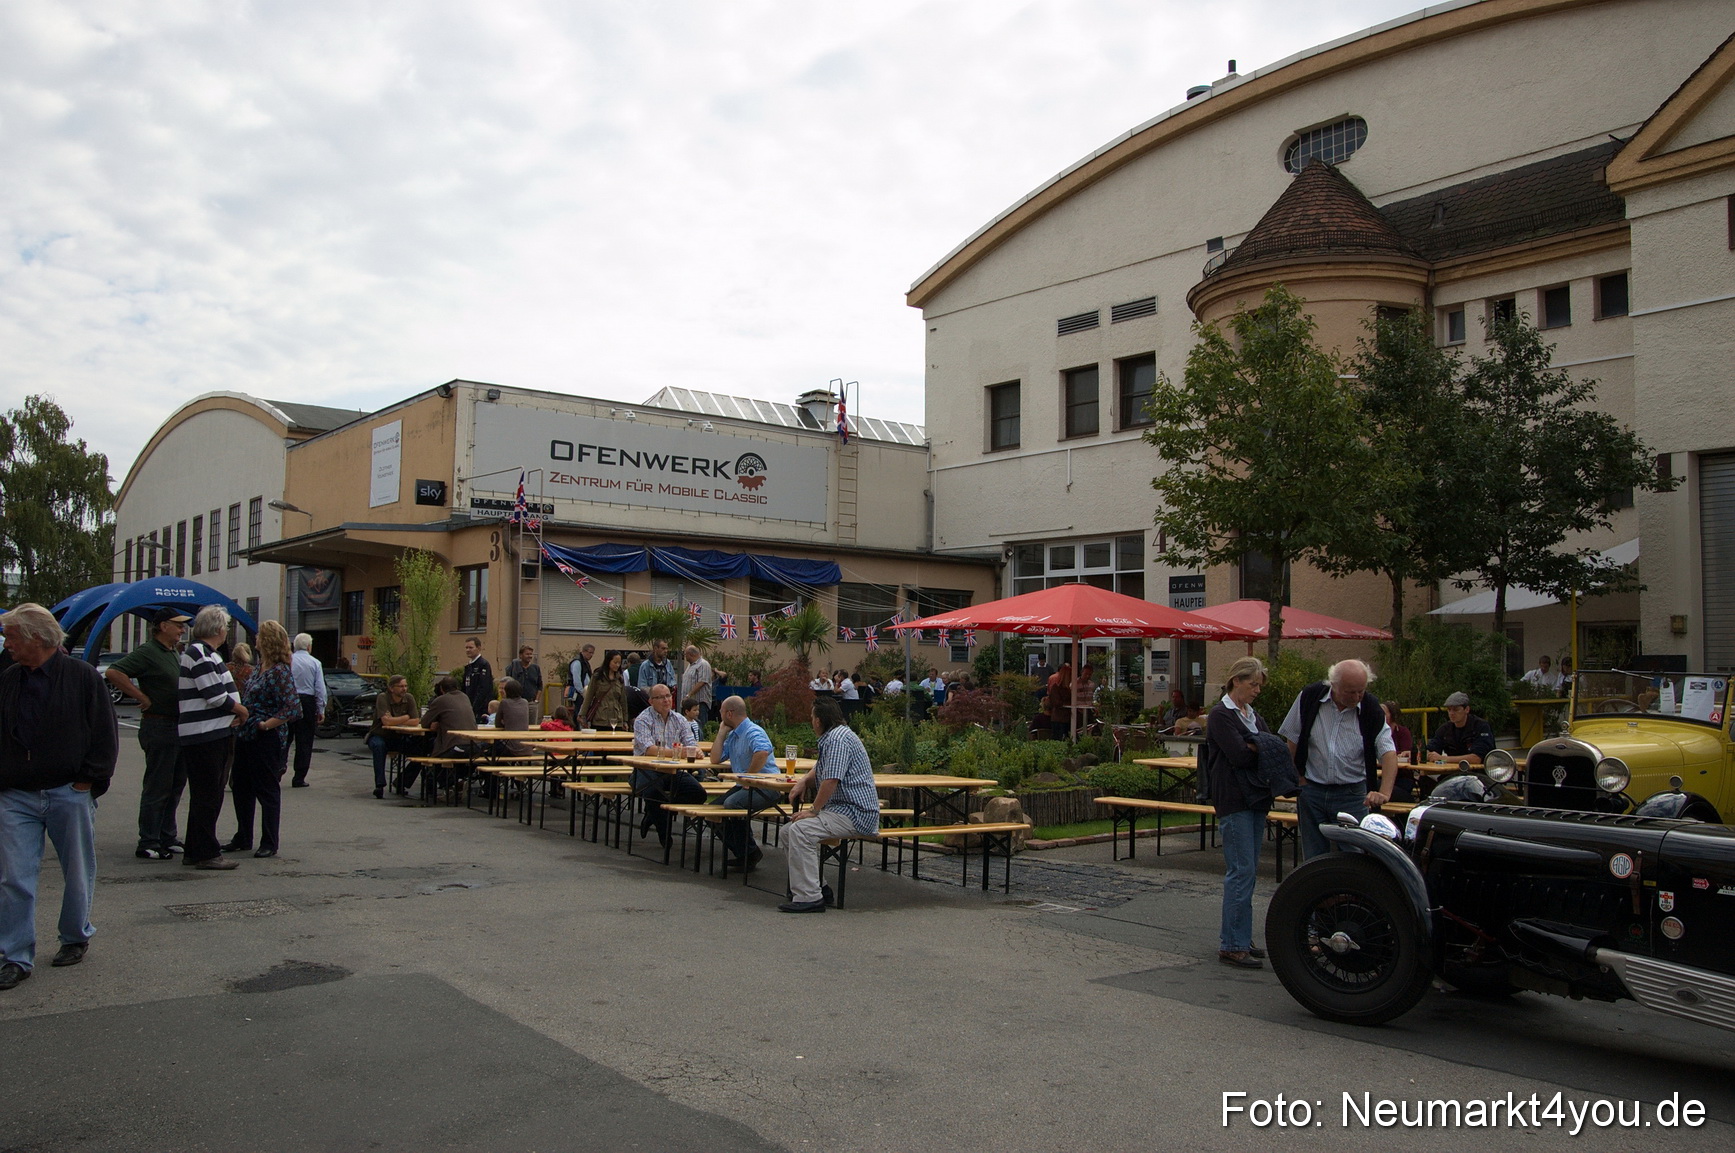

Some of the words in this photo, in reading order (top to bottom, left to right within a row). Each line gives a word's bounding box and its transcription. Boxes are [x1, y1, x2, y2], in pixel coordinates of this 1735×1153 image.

[550, 439, 732, 480] OFENWERK
[420, 485, 442, 500] sky
[549, 471, 621, 490] ZENTRUM
[626, 478, 653, 493] FÜR
[658, 483, 709, 499] MOBILE
[714, 488, 768, 505] CLASSIC
[490, 531, 500, 562] 3
[1152, 526, 1168, 553] 4
[1613, 856, 1631, 876] AGIP
